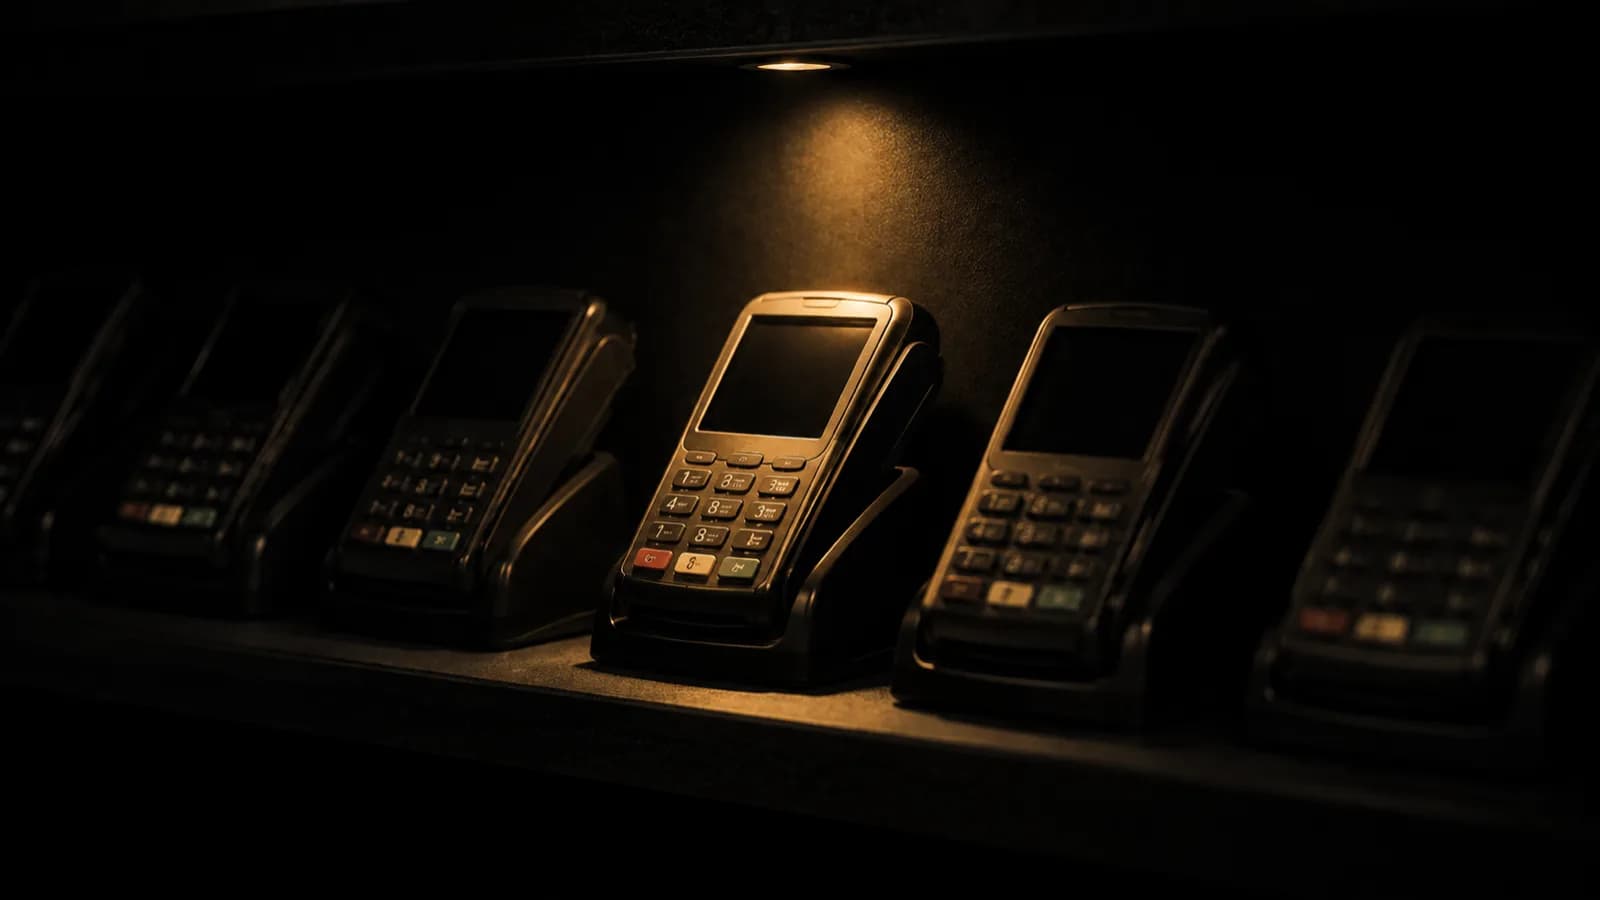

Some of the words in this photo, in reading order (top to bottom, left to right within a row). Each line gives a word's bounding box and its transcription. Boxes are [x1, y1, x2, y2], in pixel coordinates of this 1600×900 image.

[666, 497, 678, 510] 4
[708, 500, 720, 514] 8
[694, 528, 707, 542] 8
